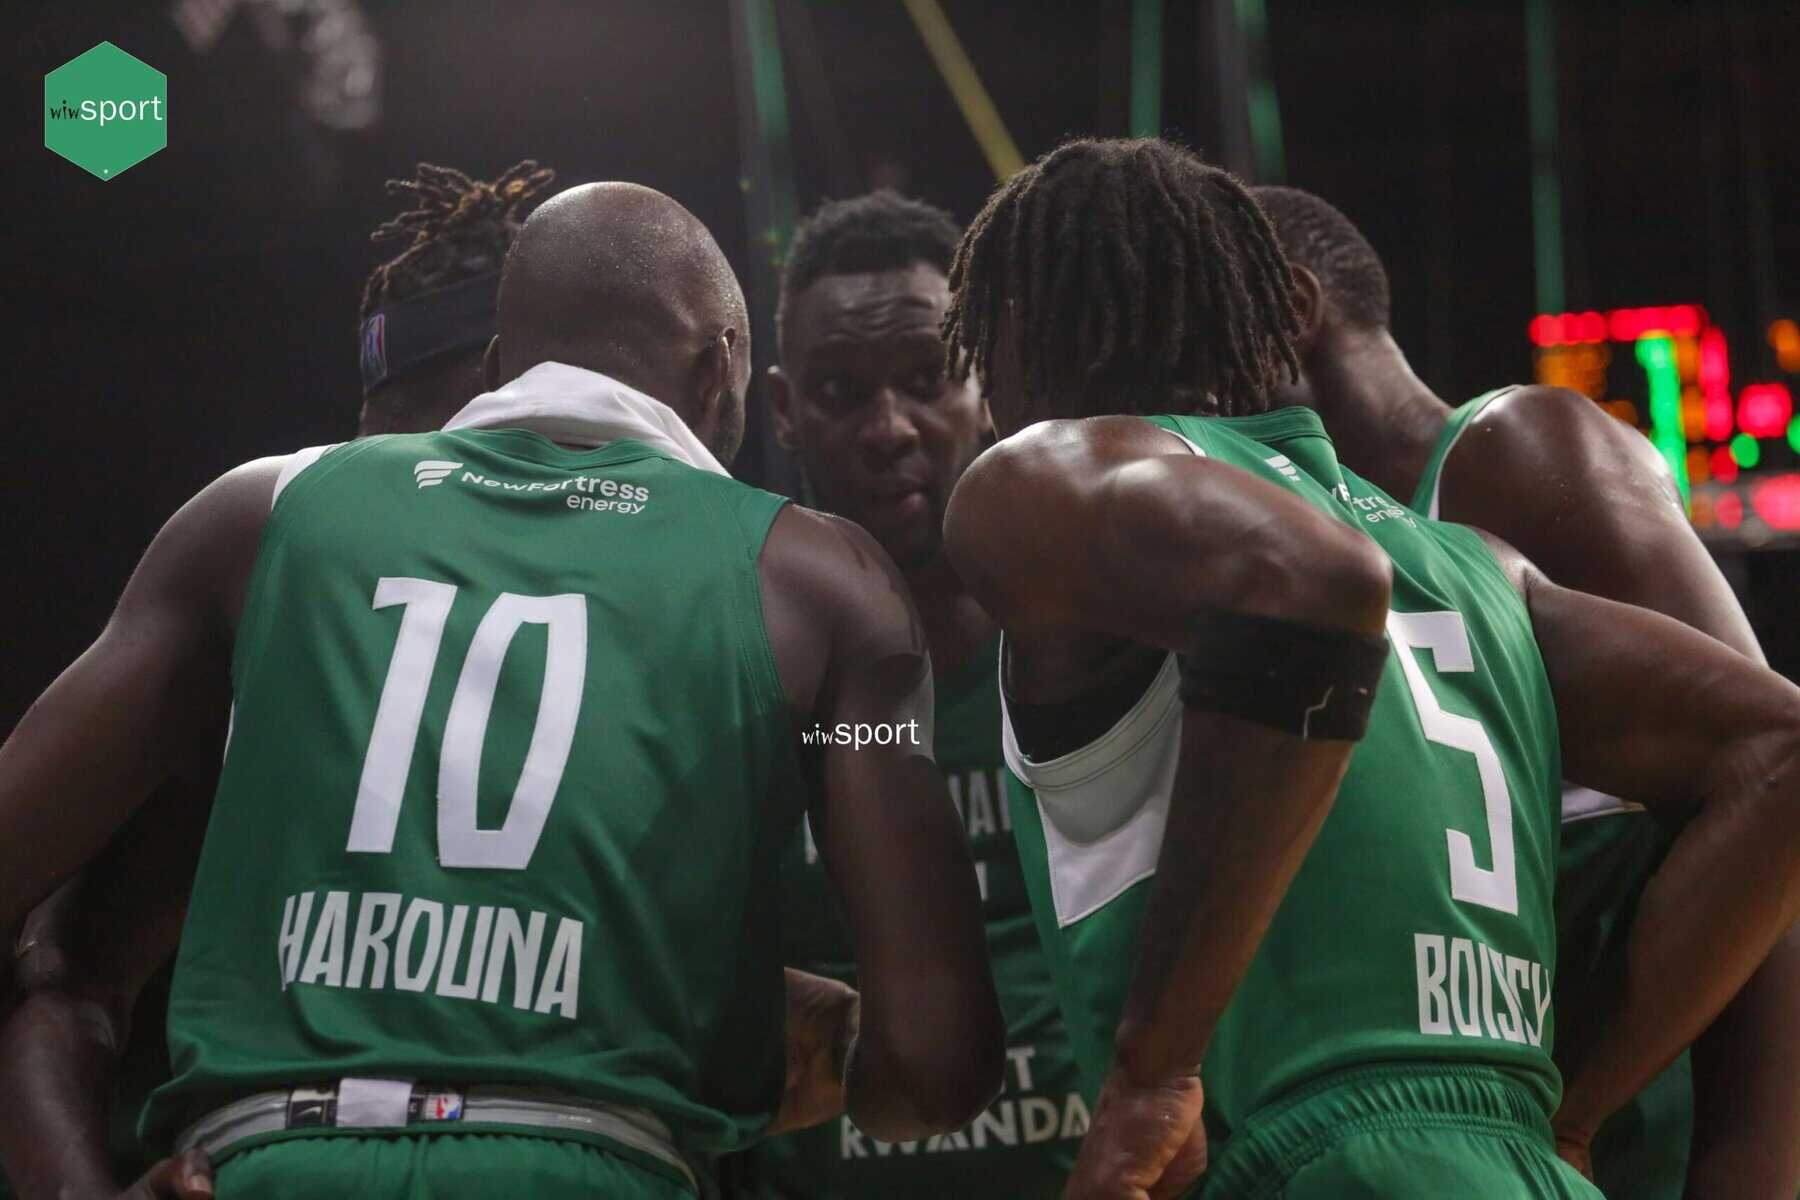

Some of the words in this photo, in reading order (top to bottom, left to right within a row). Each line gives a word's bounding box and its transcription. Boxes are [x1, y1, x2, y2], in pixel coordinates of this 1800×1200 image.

[566, 493, 645, 514] energy
[346, 577, 588, 870] 10
[1386, 610, 1519, 916] 5
[278, 891, 584, 1020] HAROUNA
